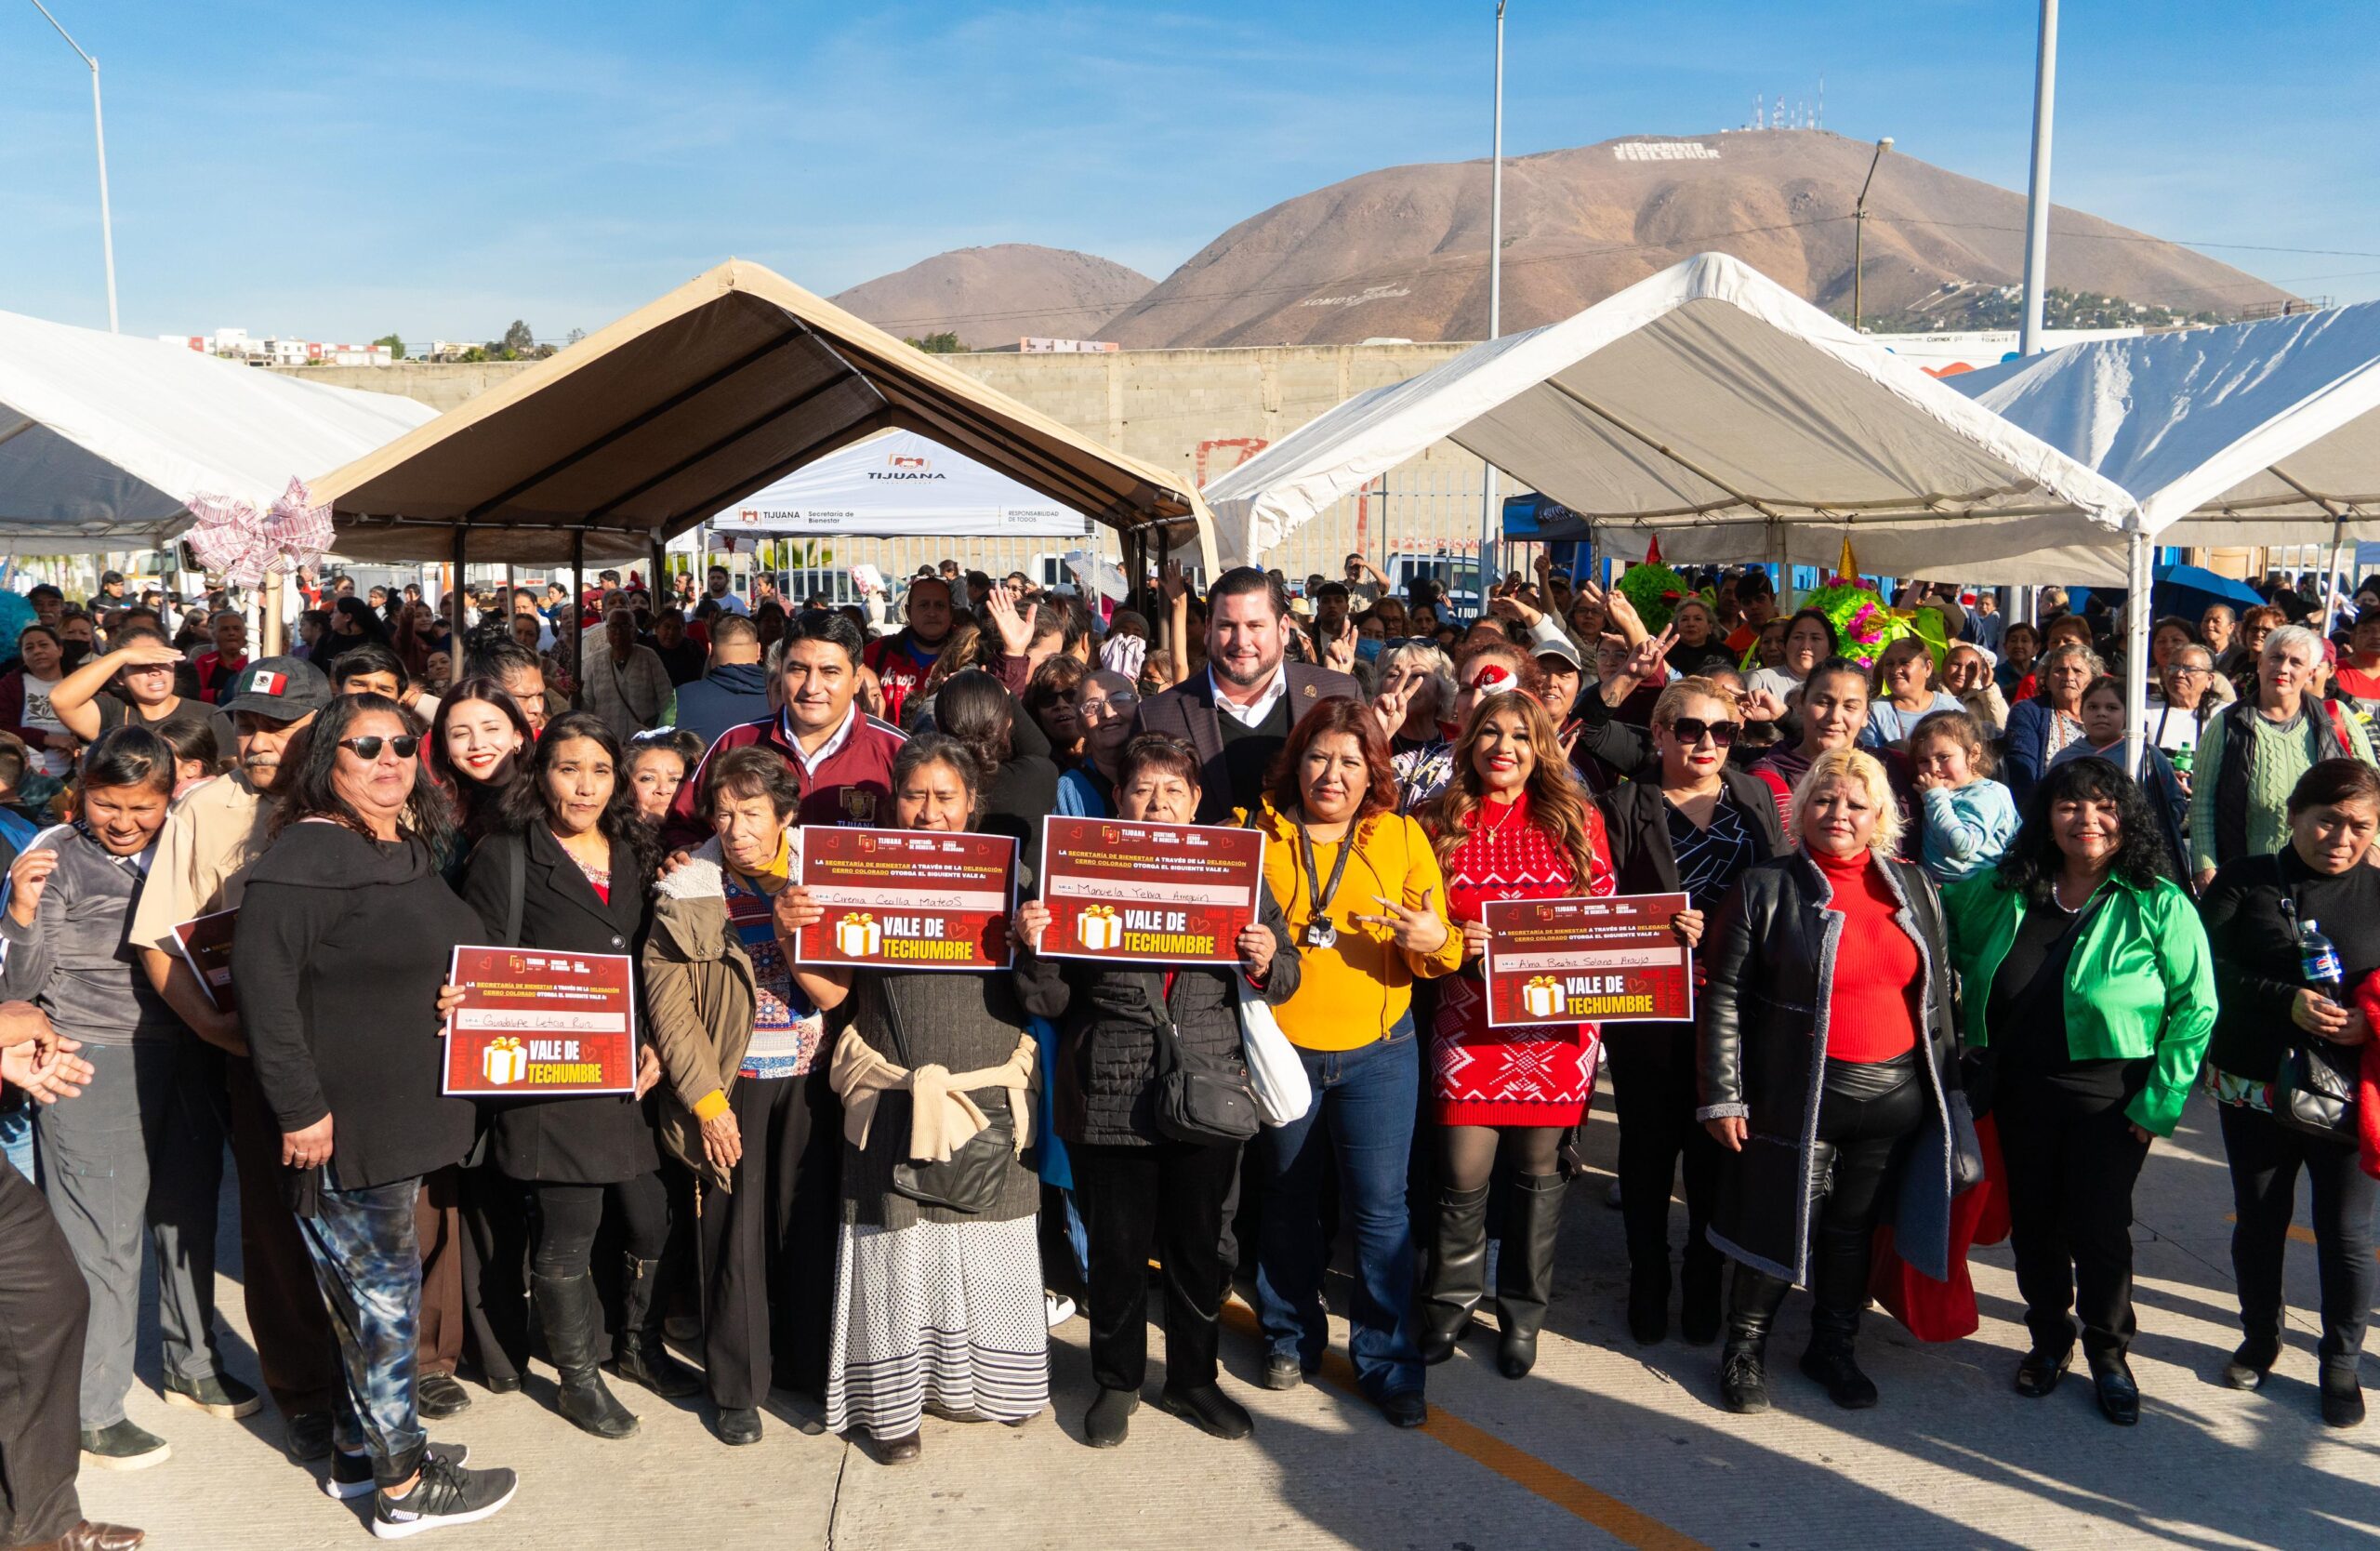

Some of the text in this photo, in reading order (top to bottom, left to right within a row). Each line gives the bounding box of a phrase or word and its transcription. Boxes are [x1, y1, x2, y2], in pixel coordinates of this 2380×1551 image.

[1613, 143, 1704, 151] JESUCRISTO
[1068, 850, 1107, 858] SECRETARÍA
[1207, 858, 1246, 867] DELEGACIÓN
[1078, 884, 1123, 897] Manuela
[883, 917, 943, 937] VALE DE
[1125, 909, 1186, 931] VALE DE
[883, 939, 973, 960] TECHUMBRE
[1124, 932, 1214, 954] TECHUMBRE
[1520, 956, 1540, 968] Alma
[1584, 958, 1612, 966] Solano
[1566, 976, 1624, 994] VALE DE
[1567, 995, 1653, 1015] TECHUMBRE
[483, 1014, 528, 1028] Guadalupe
[536, 1017, 565, 1028] Leticia
[573, 1017, 593, 1028] Ruiz
[530, 1040, 580, 1060] VALE DE
[528, 1064, 602, 1084] TECHUMBRE
[391, 1509, 419, 1521] PUMA
